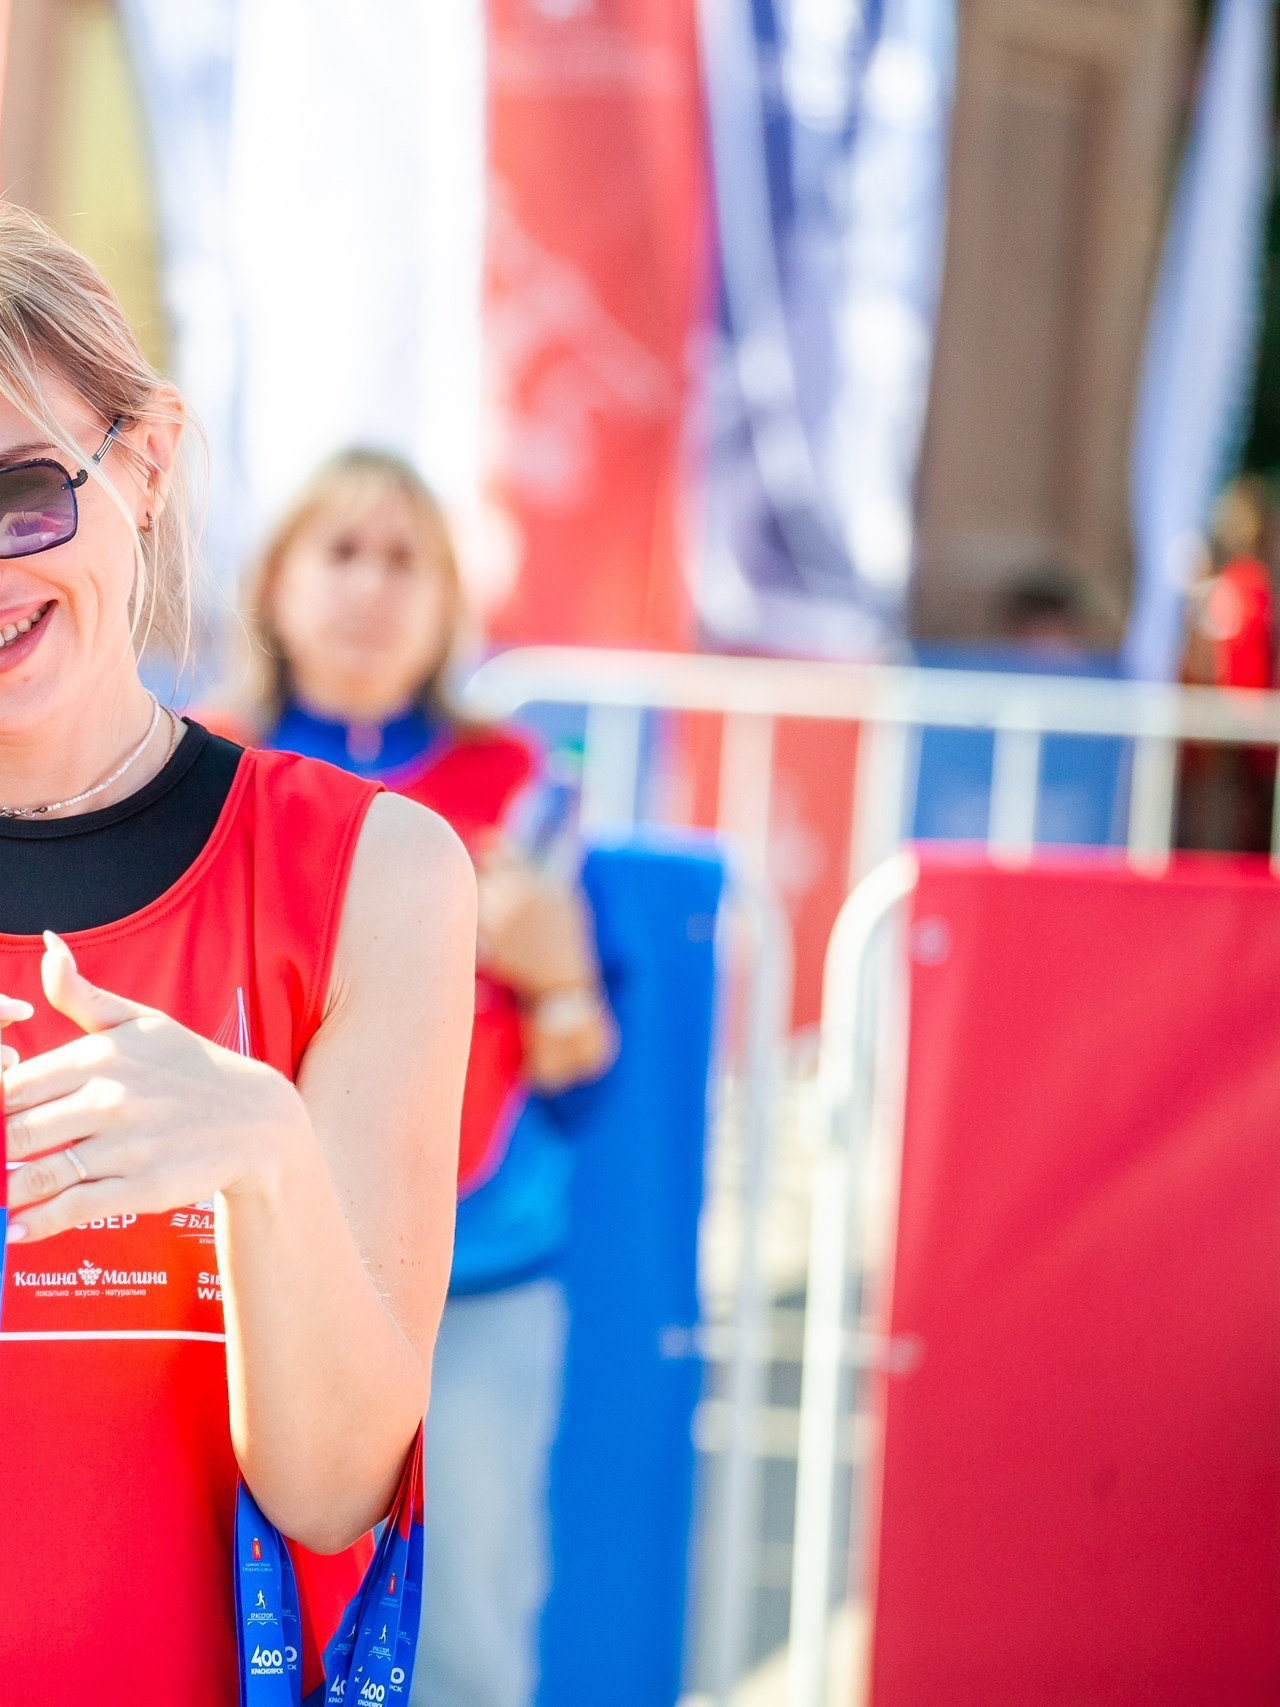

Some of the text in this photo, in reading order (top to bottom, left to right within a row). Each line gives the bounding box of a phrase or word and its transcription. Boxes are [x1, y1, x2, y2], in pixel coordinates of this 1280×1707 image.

[187, 1213, 214, 1229] БА
[13, 1271, 78, 1286] Калина
[101, 1270, 168, 1285] Малина
[74, 1290, 100, 1298] вкусно
[105, 1289, 147, 1297] натурально
[250, 1644, 283, 1668] 400
[360, 1677, 385, 1702] 400
